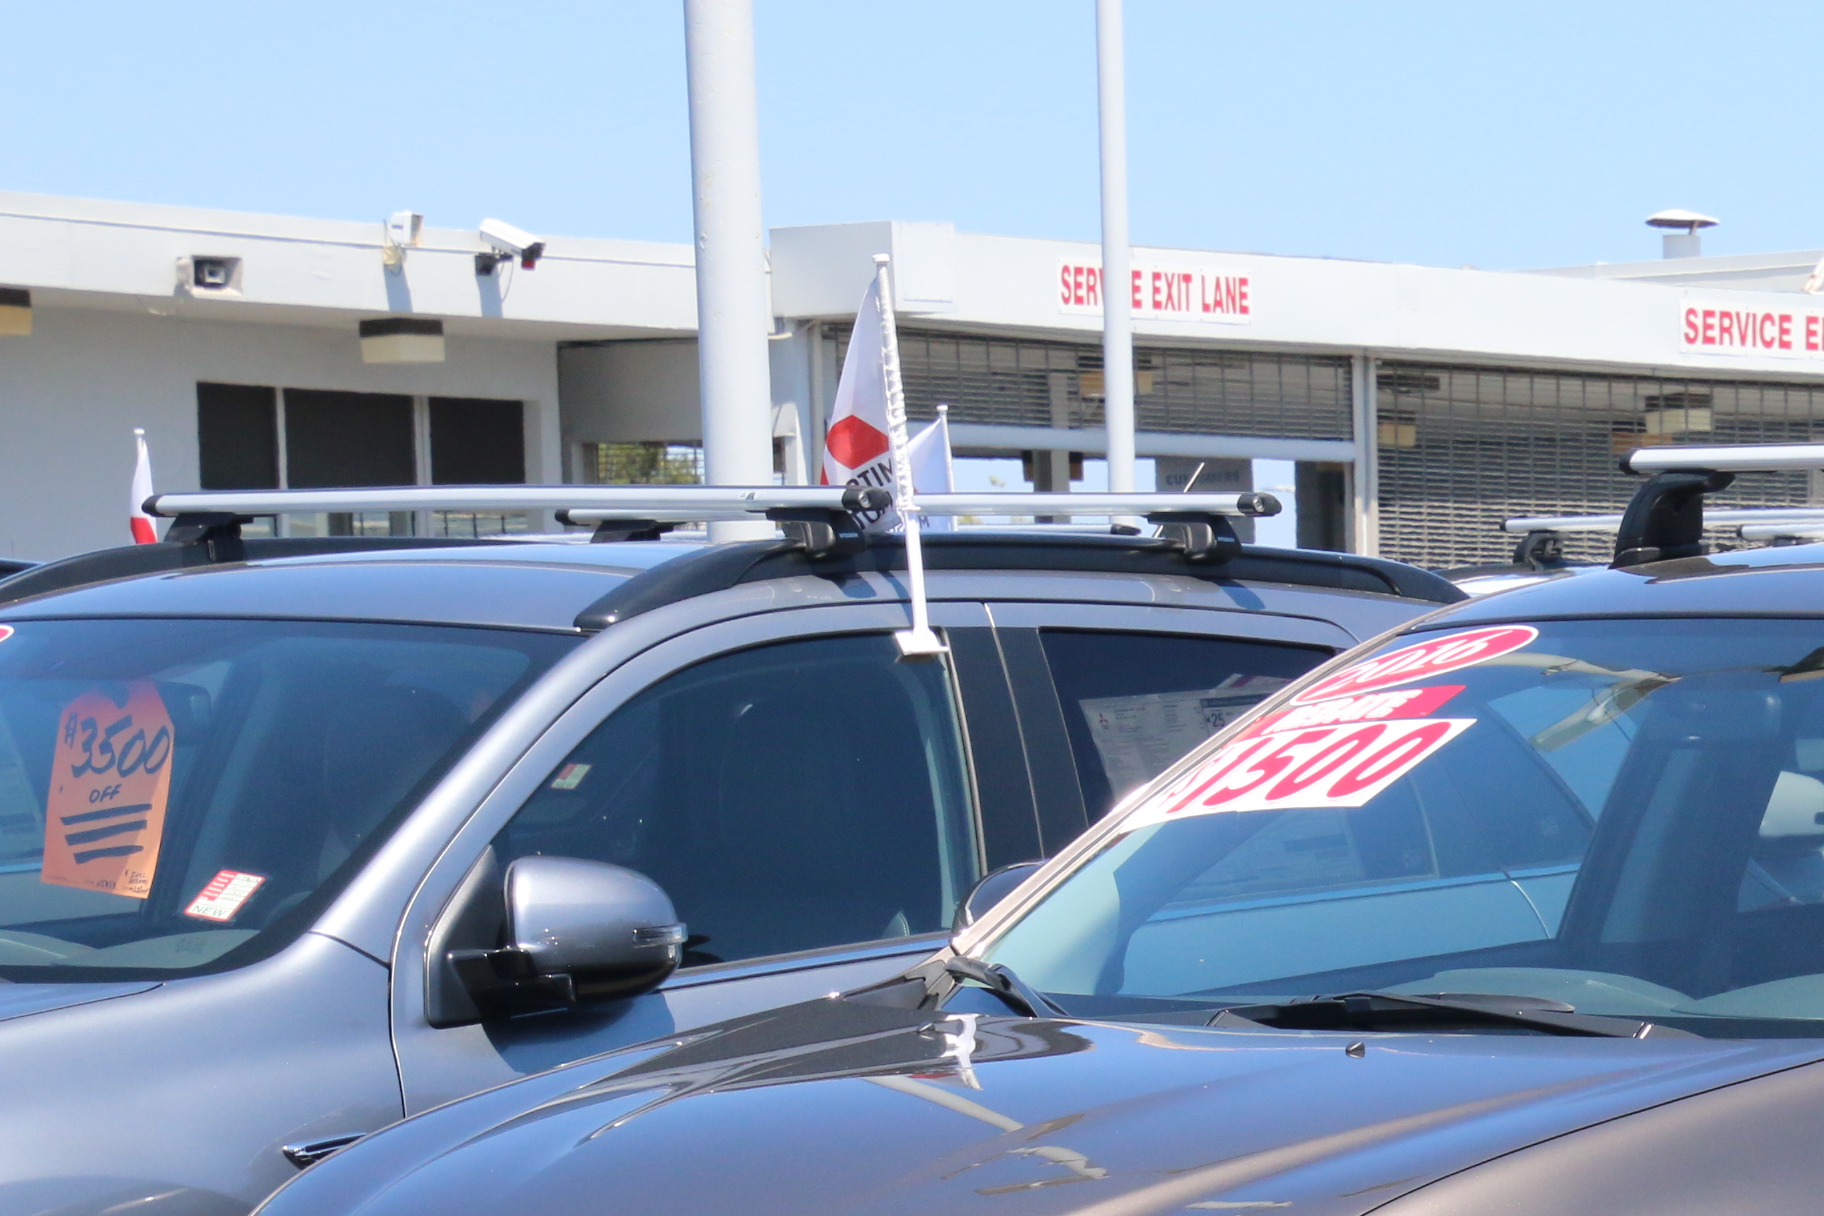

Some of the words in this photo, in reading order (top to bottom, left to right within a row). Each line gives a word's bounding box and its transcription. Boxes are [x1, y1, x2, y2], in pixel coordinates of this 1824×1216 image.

[1061, 265, 1142, 309] SERE
[1152, 271, 1192, 312] EXIT
[1201, 275, 1249, 315] LANE
[1683, 307, 1793, 350] SERVICE
[1299, 629, 1514, 702] 2016
[1261, 688, 1423, 735] REBATE
[1156, 721, 1452, 813] $1500
[89, 783, 122, 804] OFF
[191, 905, 228, 917] NEW
